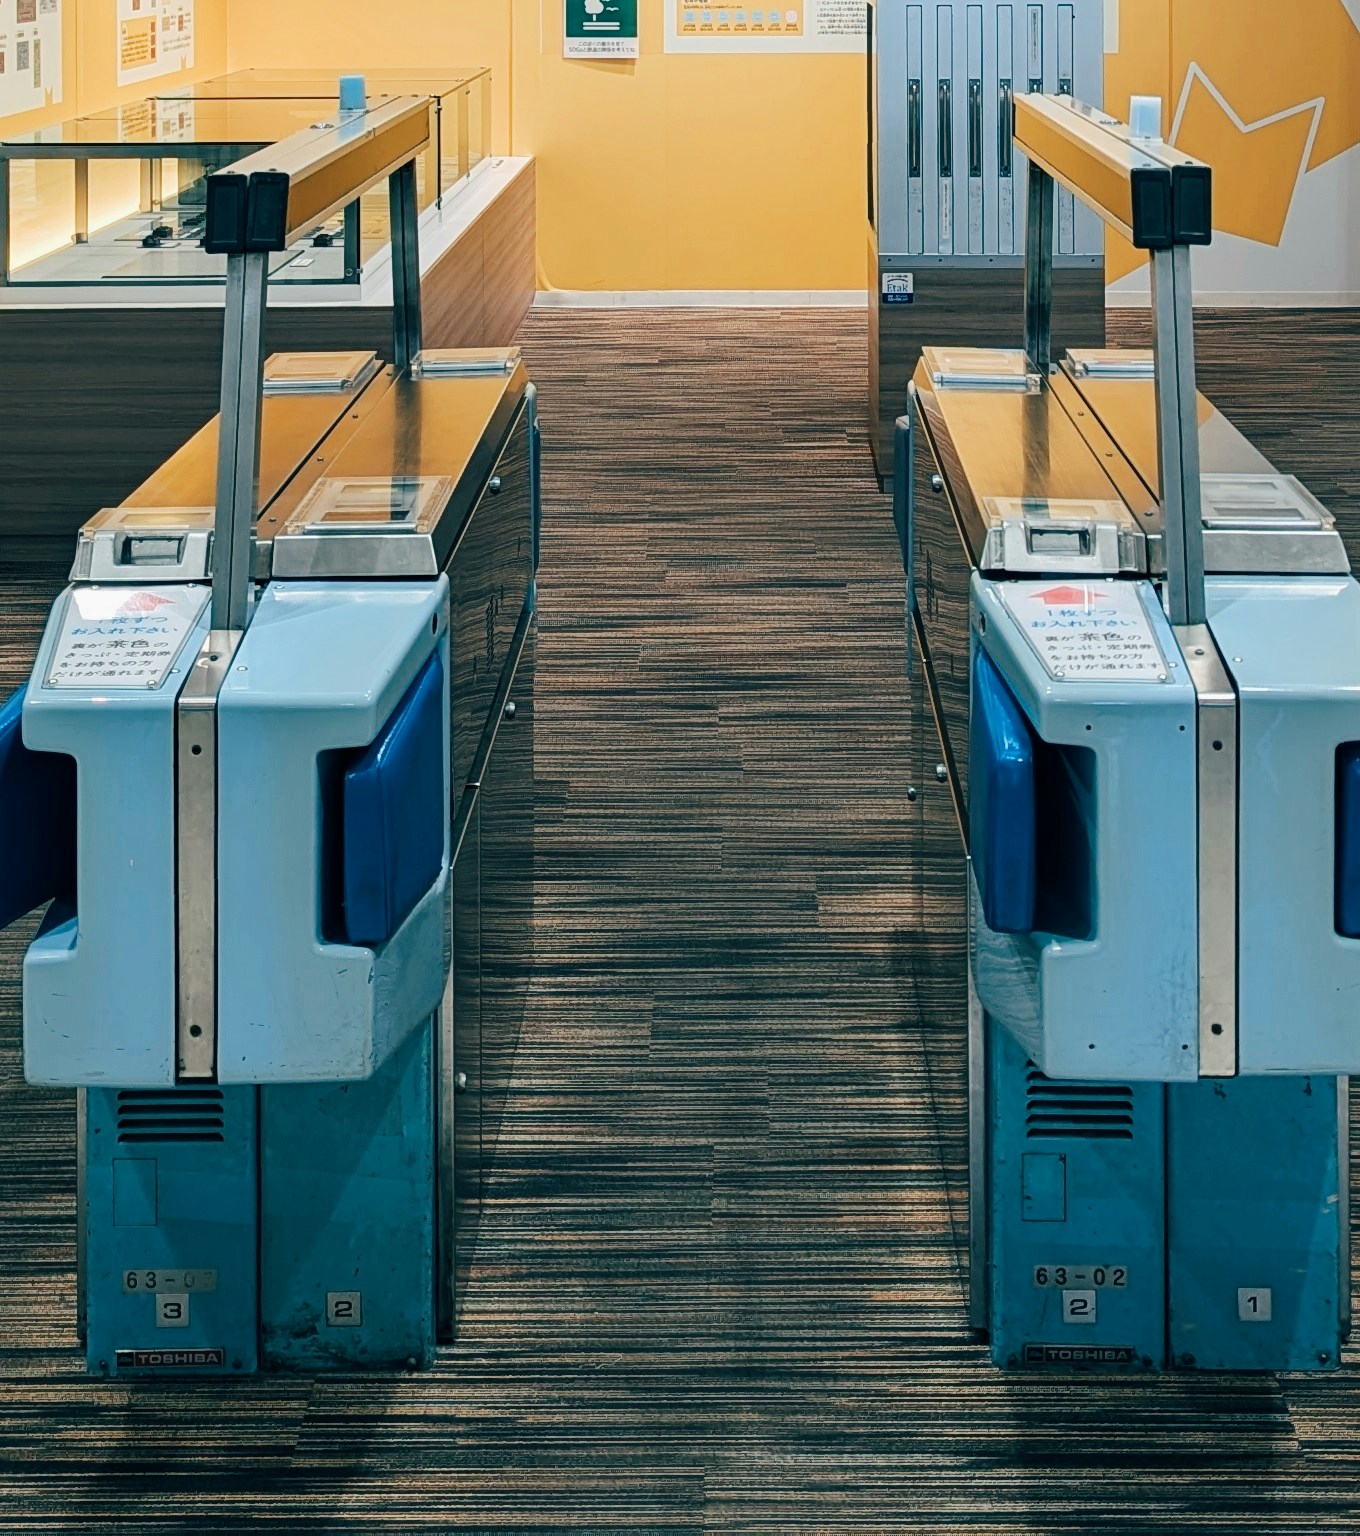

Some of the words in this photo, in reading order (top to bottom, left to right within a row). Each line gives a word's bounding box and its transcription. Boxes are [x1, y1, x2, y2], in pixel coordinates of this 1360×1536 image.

[1031, 620, 1137, 628] お入れ下さい
[71, 627, 178, 635] お入れ下さい
[71, 639, 168, 649] 裏が茶色の
[60, 660, 154, 668] をお持ちの方
[1036, 1267, 1126, 1287] 63-02
[163, 1302, 182, 1319] 3
[334, 1300, 354, 1318] 2
[1070, 1298, 1089, 1316] 2
[1247, 1296, 1259, 1314] 1
[139, 1353, 219, 1364] TOSHIBA
[1048, 1349, 1128, 1361] TOSHIBA
